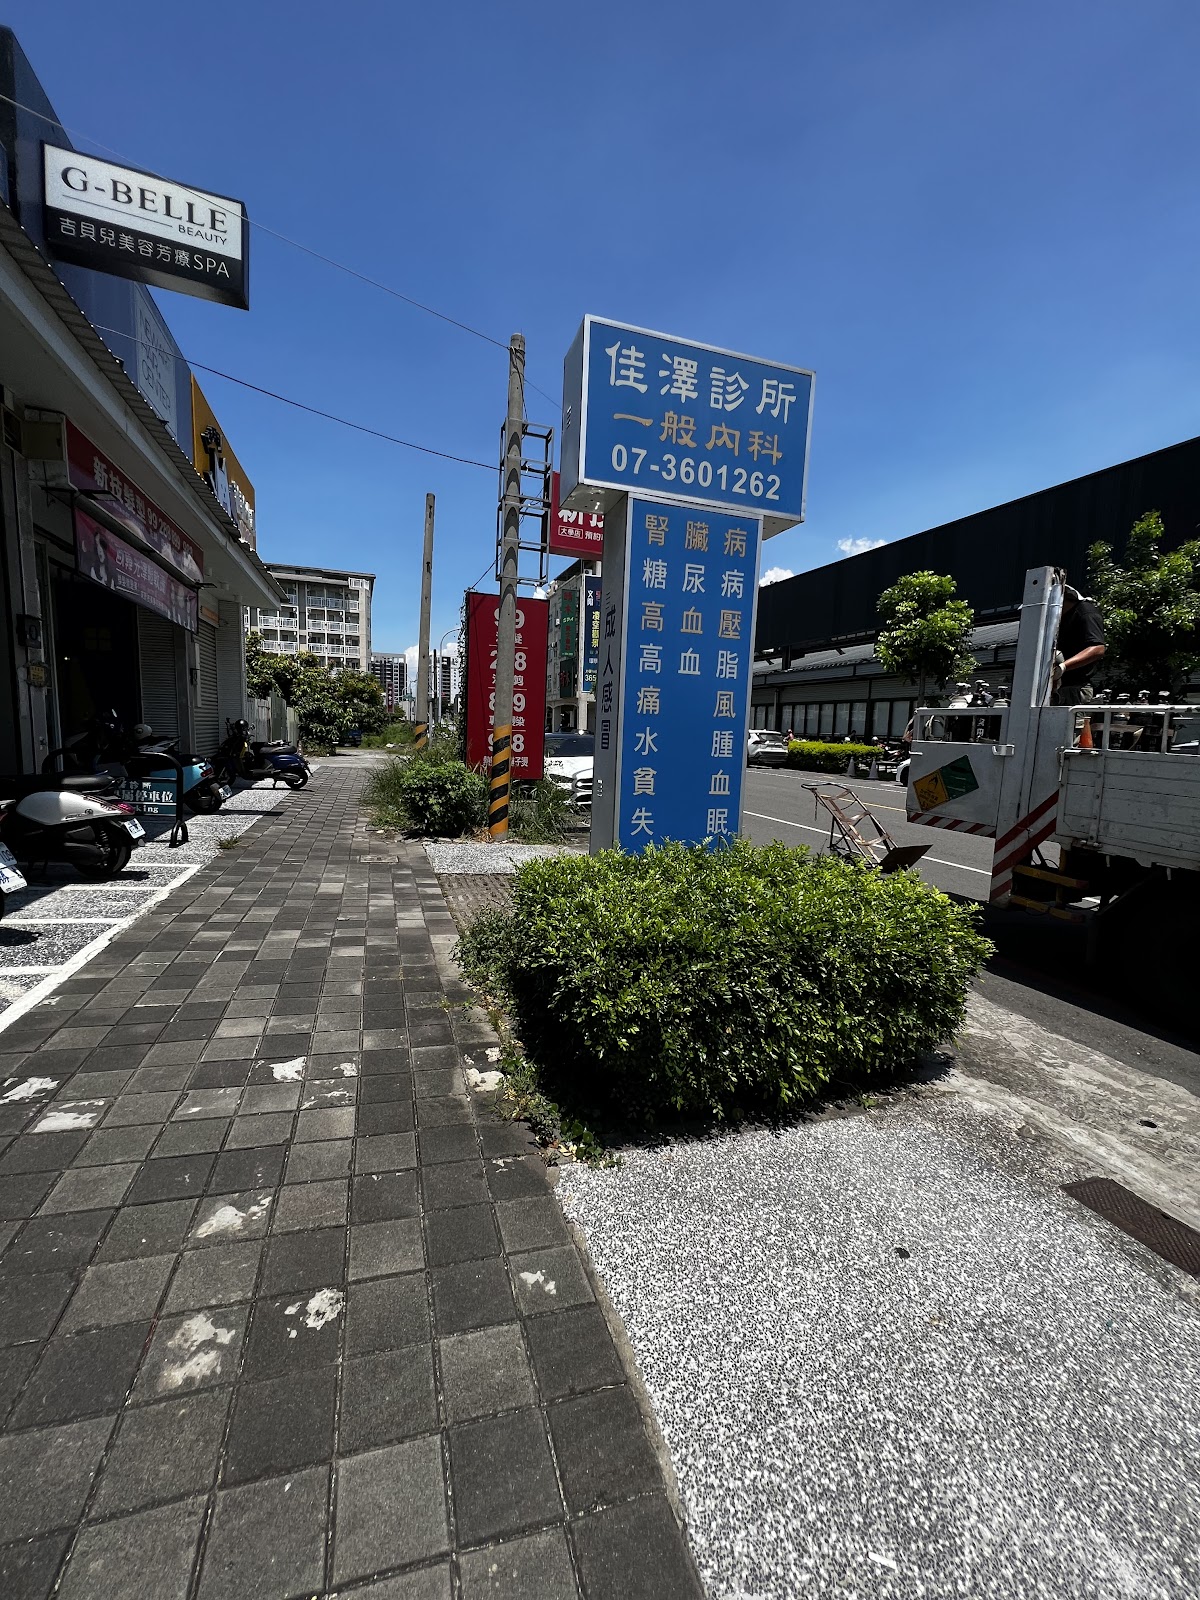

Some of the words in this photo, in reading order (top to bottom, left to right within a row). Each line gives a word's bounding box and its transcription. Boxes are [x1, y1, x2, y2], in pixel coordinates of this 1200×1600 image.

[61, 166, 227, 233] G-BELLE
[59, 217, 230, 278] 吉貝兒美容芳療SPA
[178, 224, 227, 246] BEAUTY
[605, 341, 797, 424] 佳澤診所
[613, 410, 783, 466] 一般內科
[611, 444, 782, 500] 07-3601262
[645, 514, 748, 558] 腎臟病
[642, 557, 745, 599] 糖尿病
[641, 601, 742, 640] 高血壓
[489, 650, 527, 671] 28
[601, 604, 616, 750] 成人感冒
[639, 643, 739, 680] 高血脂
[636, 686, 736, 718] 痛風
[634, 727, 734, 758] 水腫
[632, 767, 731, 796] 貧血
[630, 807, 729, 836] 失眠
